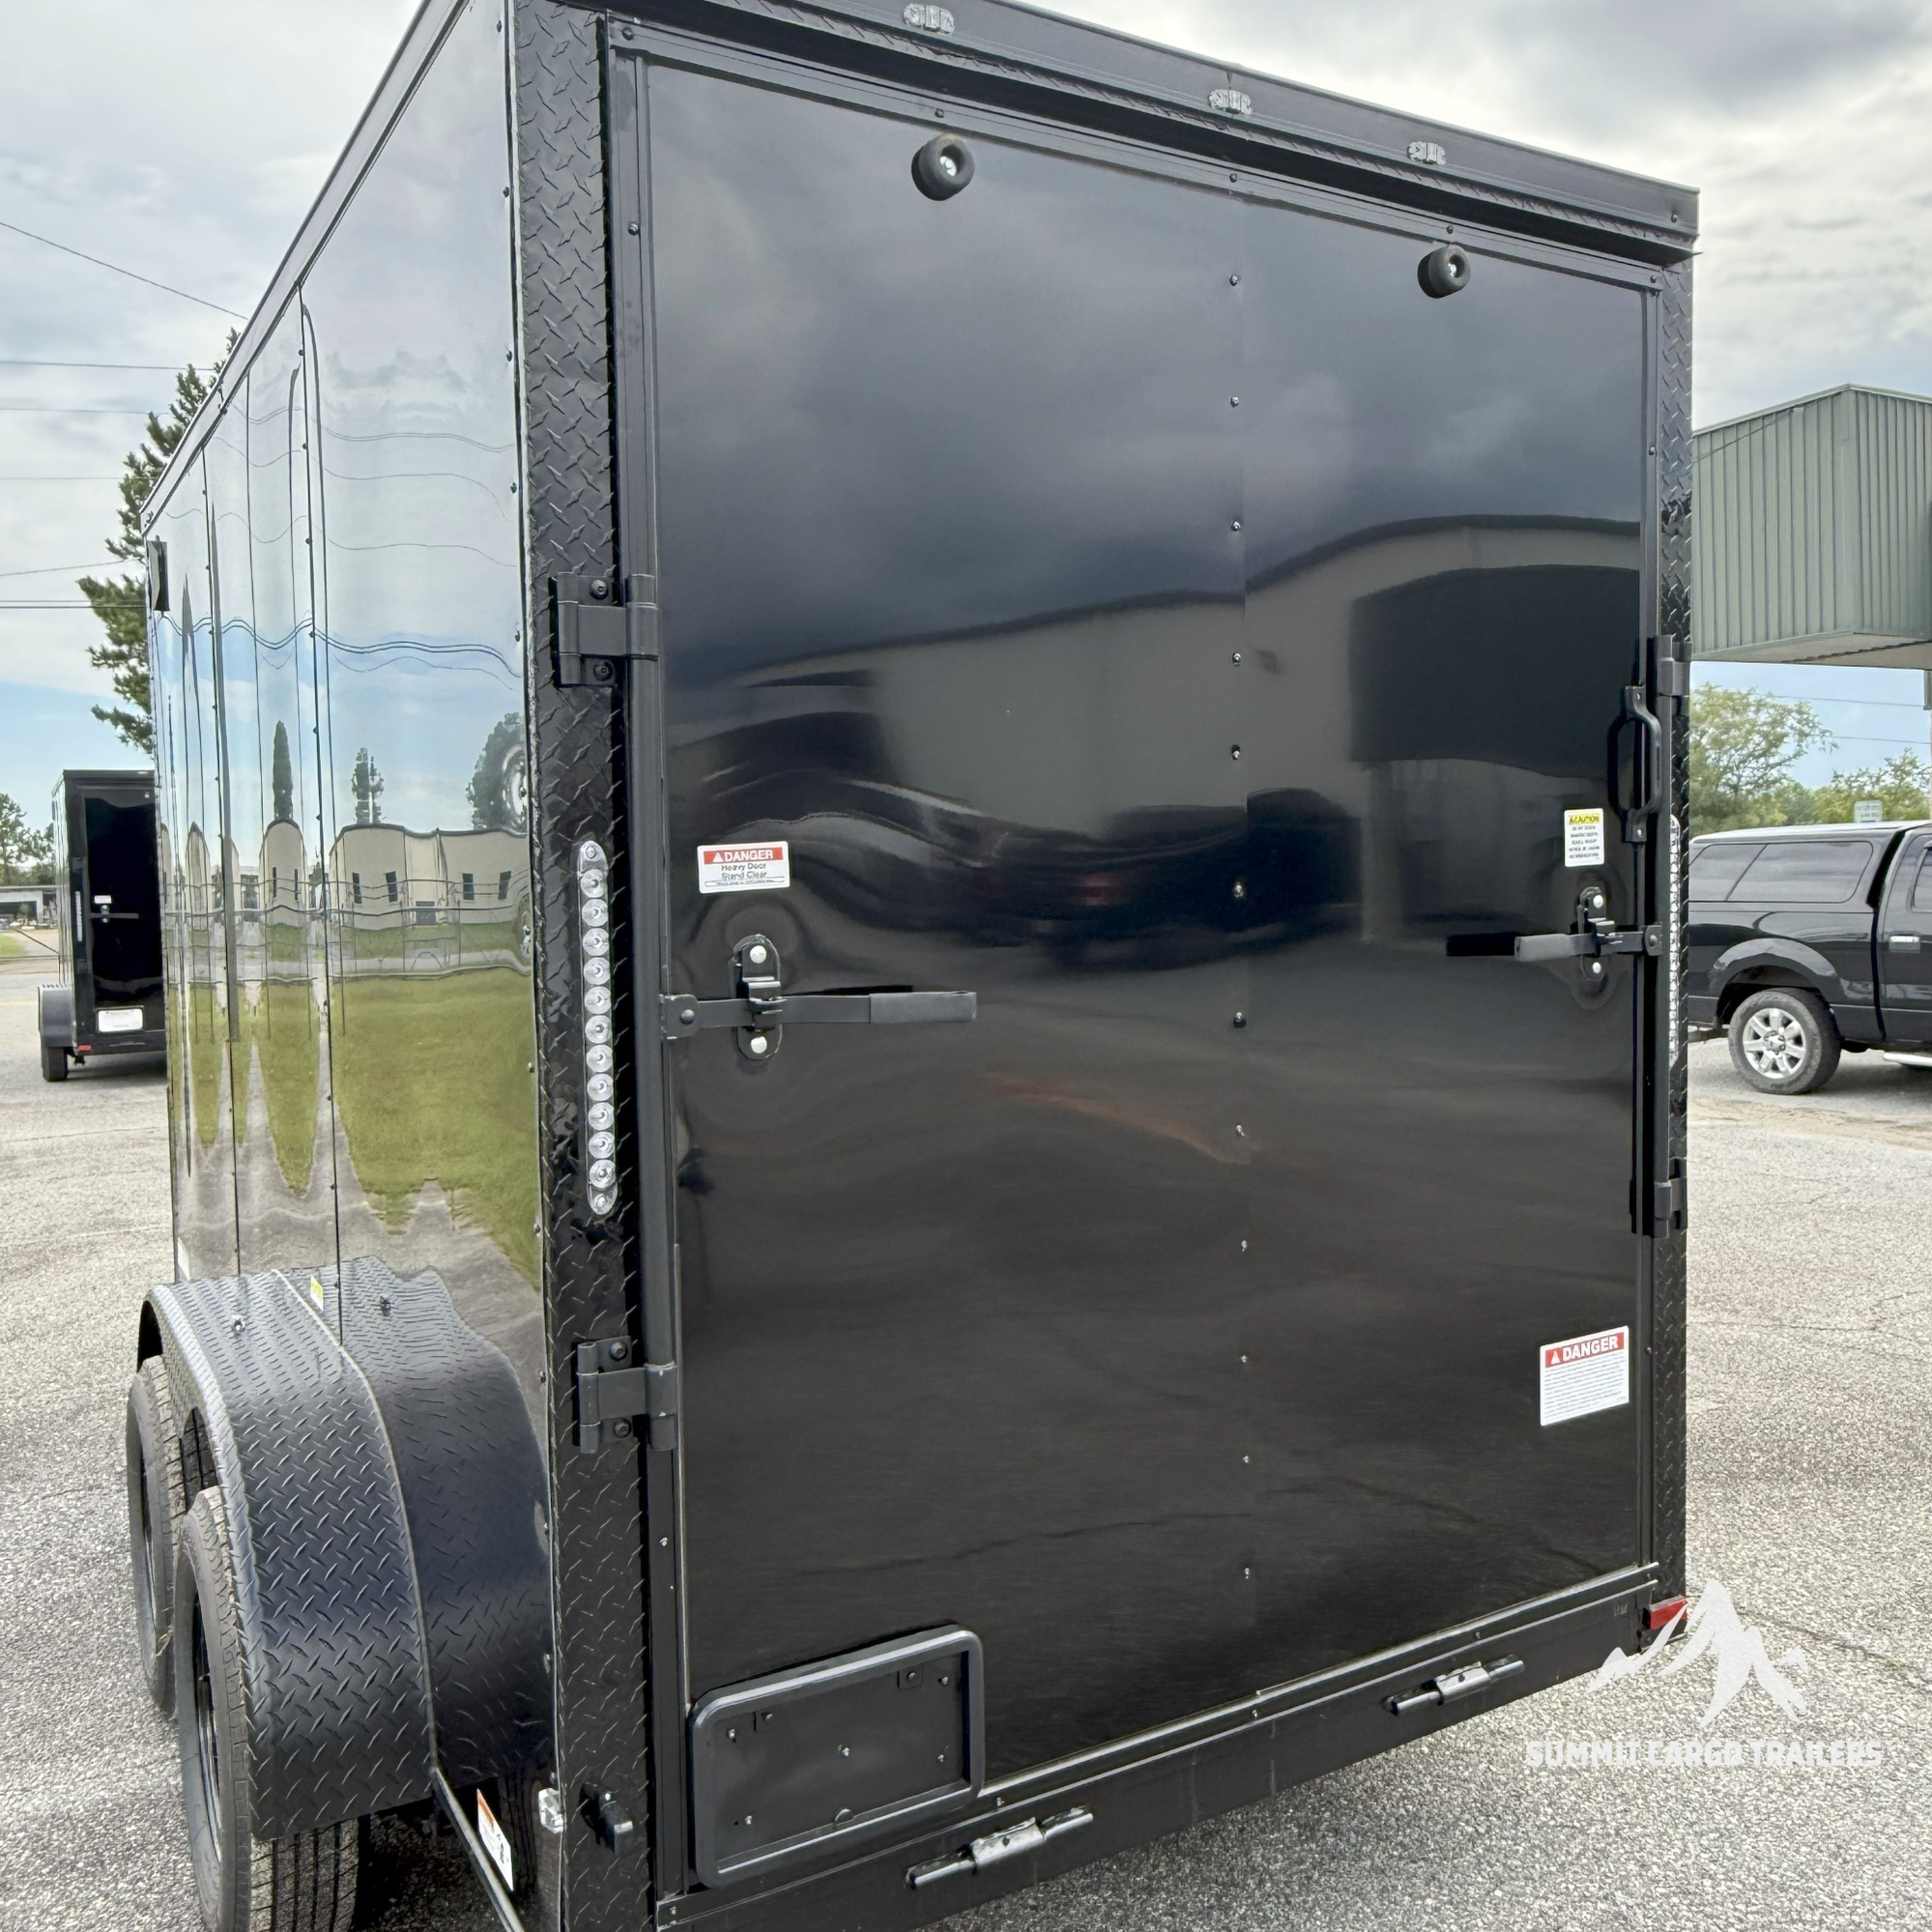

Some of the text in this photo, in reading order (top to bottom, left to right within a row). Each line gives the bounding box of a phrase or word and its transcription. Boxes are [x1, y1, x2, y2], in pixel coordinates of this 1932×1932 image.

[724, 849, 773, 862] DANGER
[721, 863, 745, 872] Heavy
[1562, 1336, 1618, 1362] DANGER
